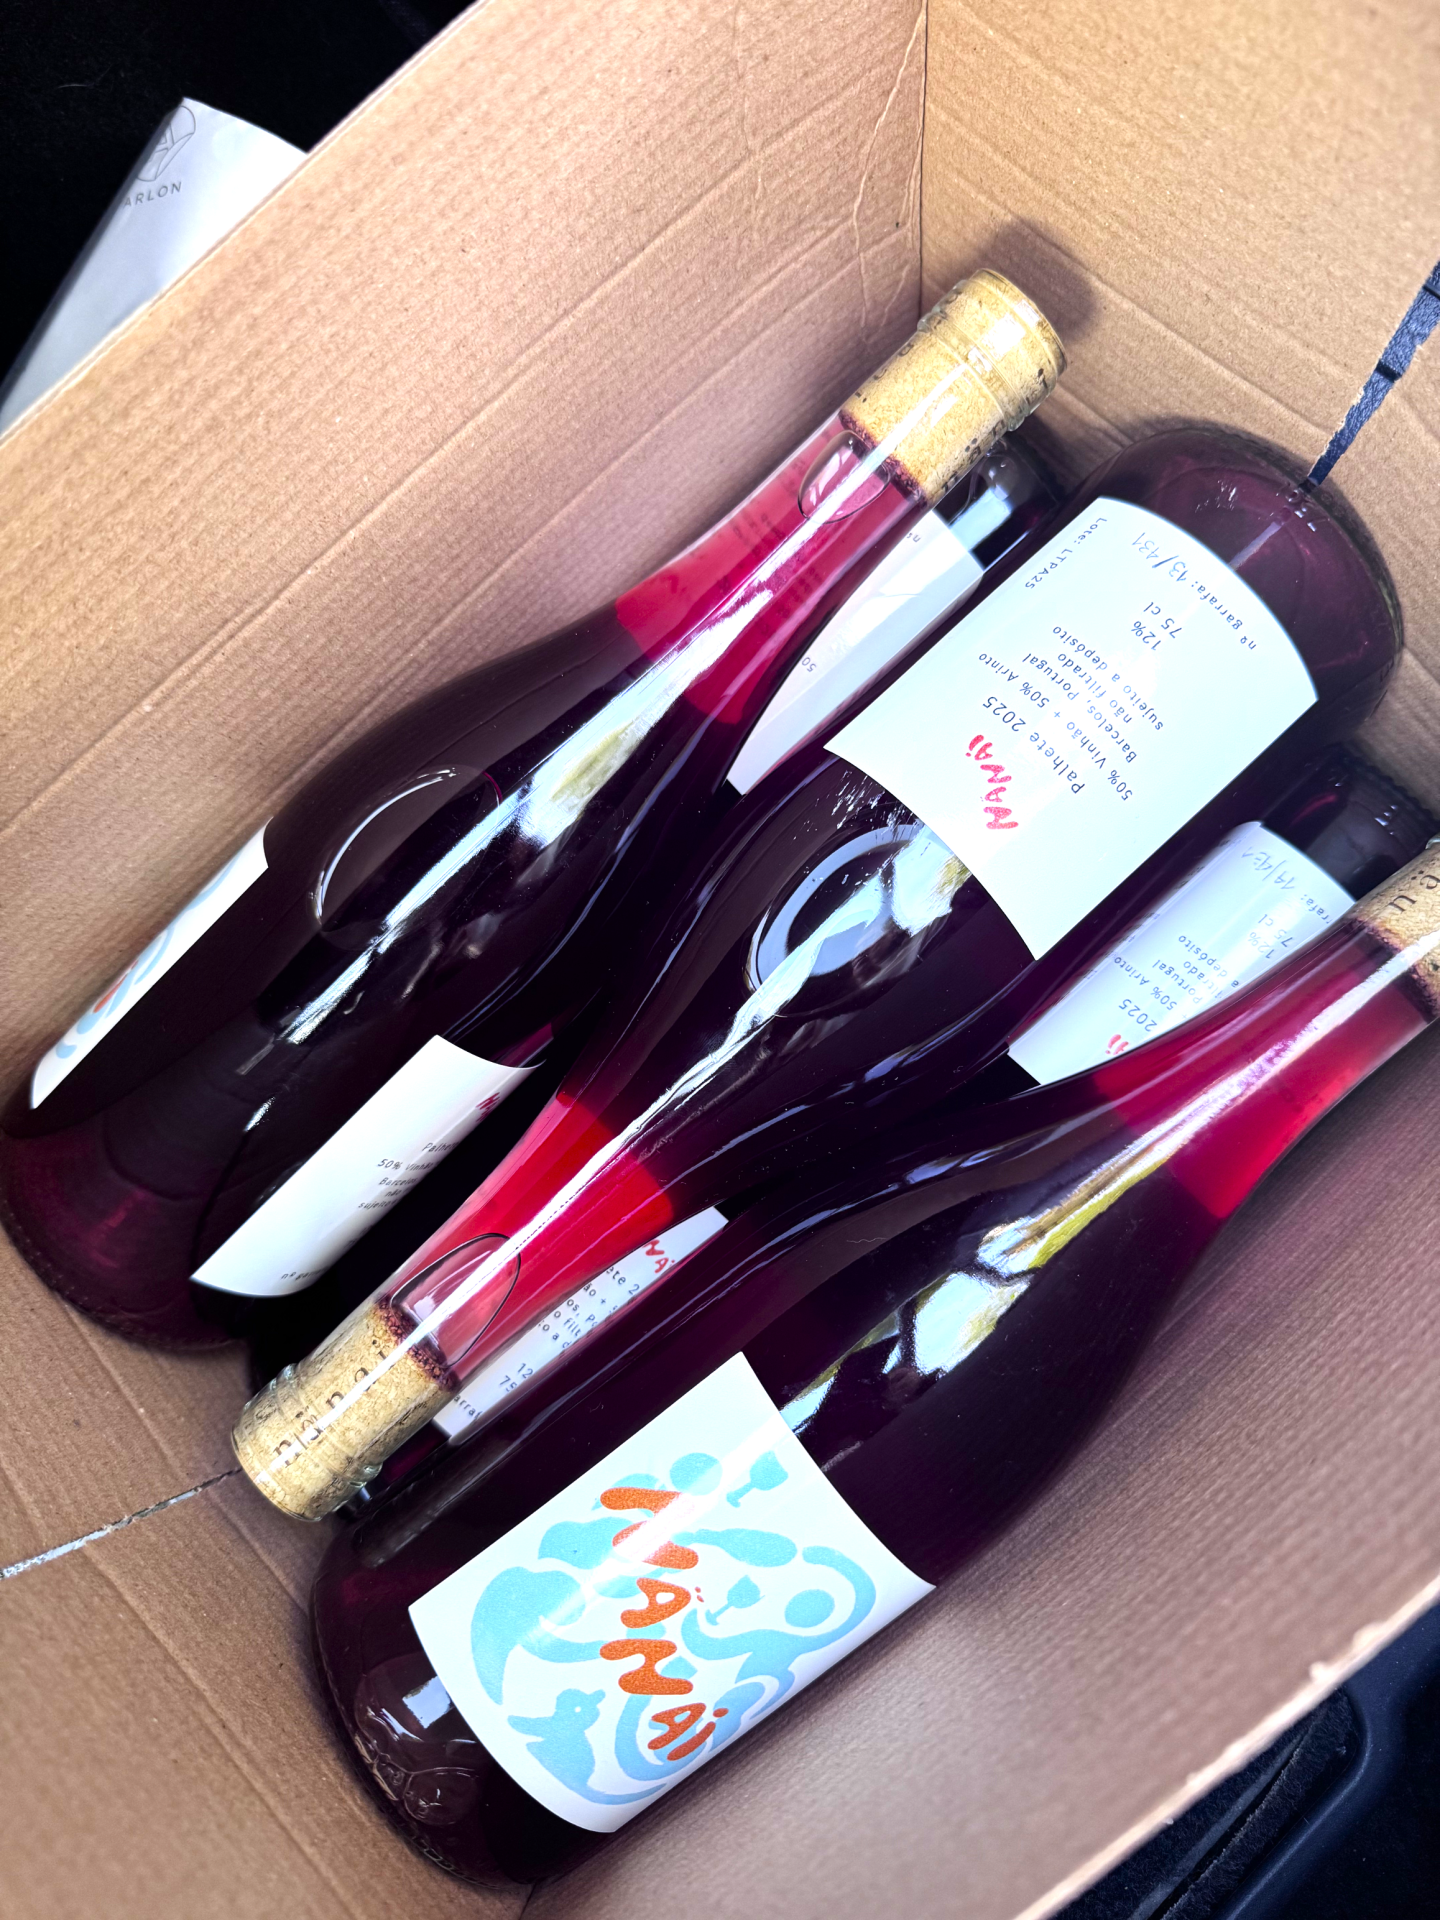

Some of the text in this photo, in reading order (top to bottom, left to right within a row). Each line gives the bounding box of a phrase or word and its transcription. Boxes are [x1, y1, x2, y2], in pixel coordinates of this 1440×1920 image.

[1024, 517, 1108, 590] Lote: LTPA25
[1143, 601, 1183, 639] 75 cl
[1190, 580, 1243, 630] garrafa:
[1131, 620, 1162, 651] 12%
[978, 653, 1019, 682] Arinto
[1052, 626, 1164, 731] sujeito a depósito
[1019, 681, 1050, 708] 50%
[1057, 653, 1132, 724] não filtrado
[1022, 653, 1137, 763] Barcelos, Portugal
[982, 696, 1085, 794] Palhete 2025
[1066, 721, 1107, 769] Vinhão
[1107, 769, 1133, 801] 50%
[1247, 931, 1275, 959] 12%
[1257, 913, 1294, 948] 75 cl
[1113, 956, 1150, 986] Arinto
[1177, 934, 1228, 978] depósito
[1150, 986, 1177, 1011] 50%
[1152, 959, 1202, 1005] Portugal
[1183, 960, 1223, 999] iltrado
[1118, 998, 1158, 1032] 2025
[376, 1158, 403, 1170] 50%
